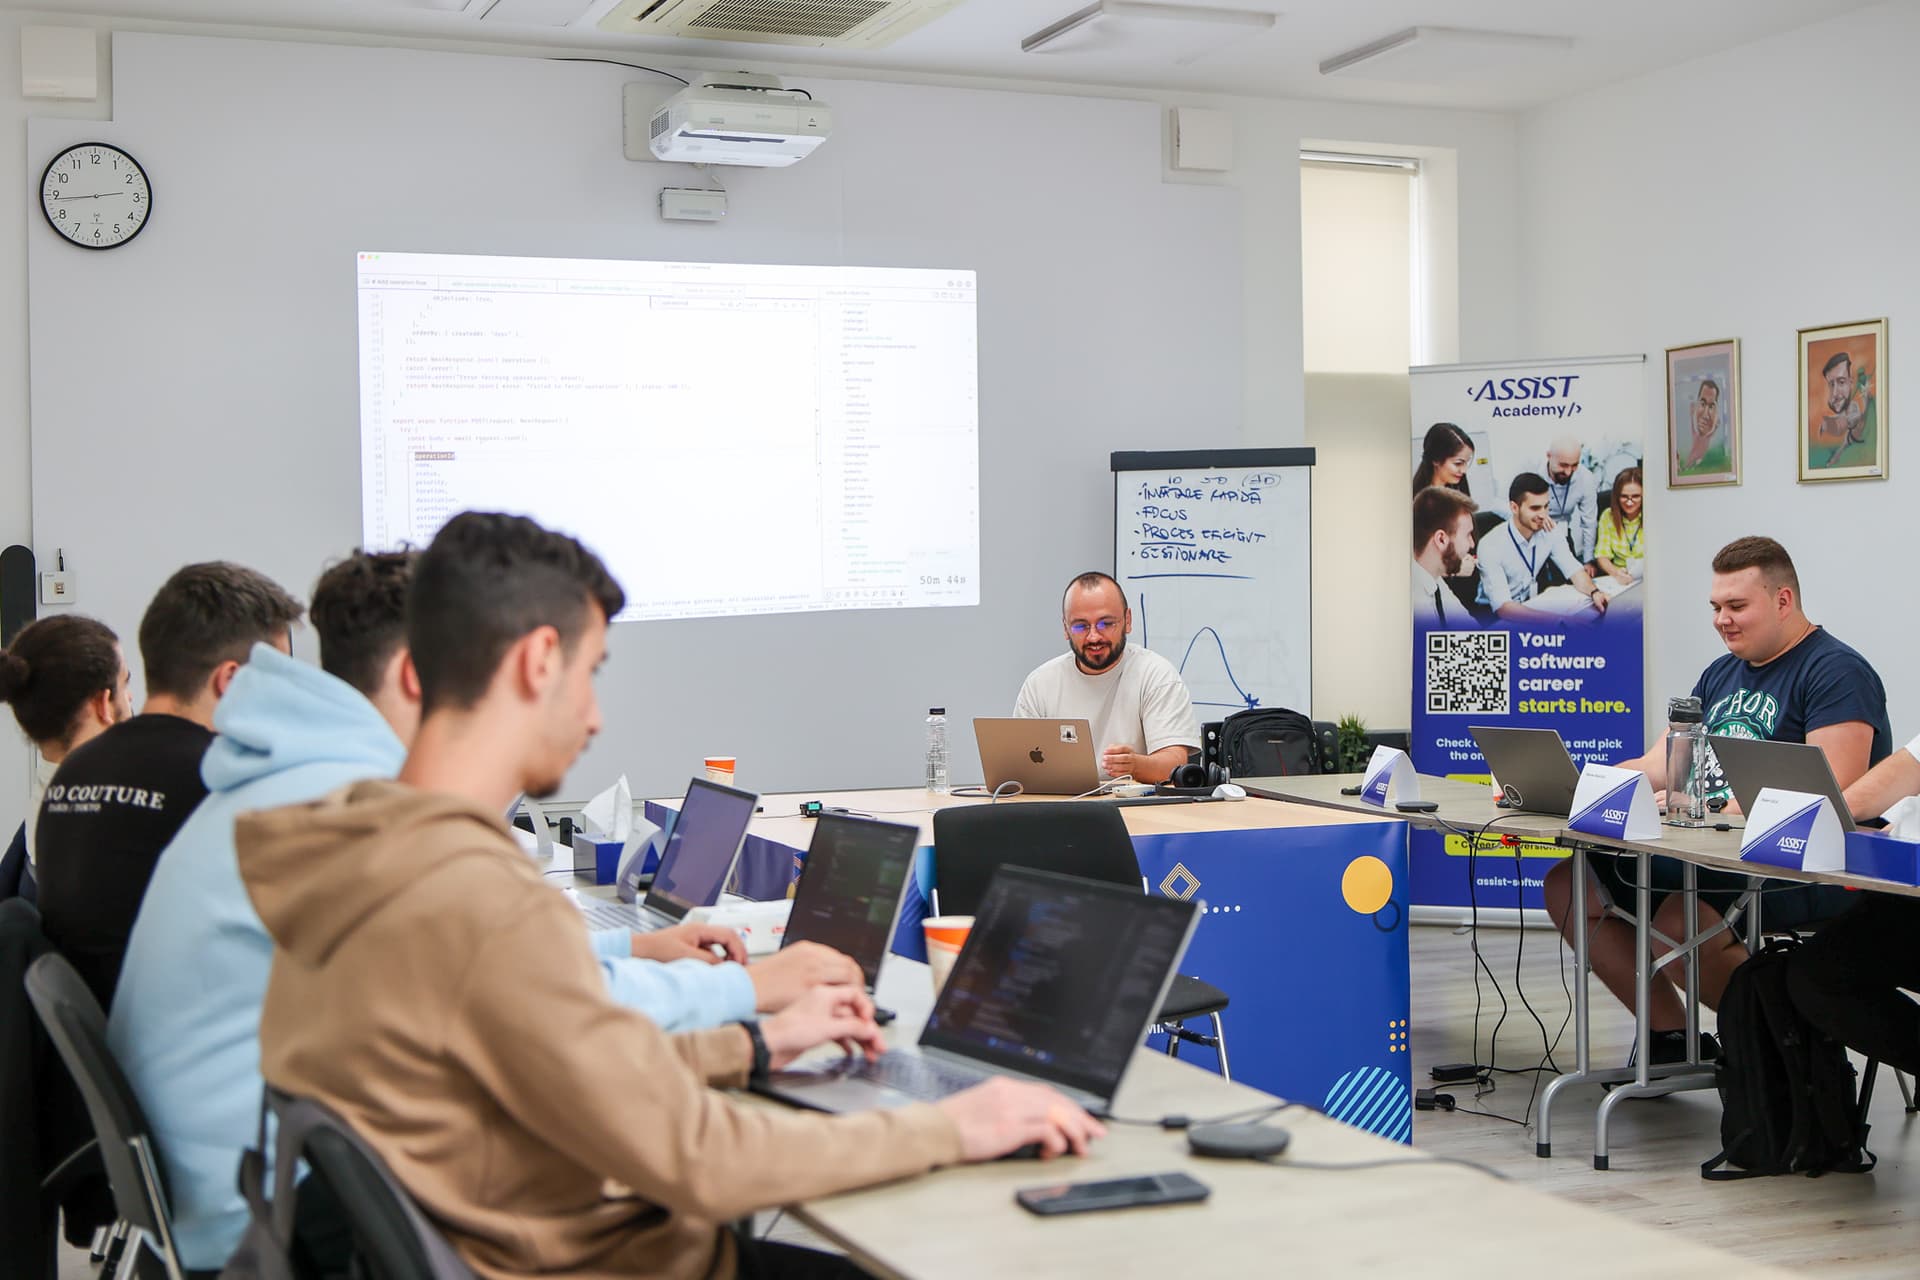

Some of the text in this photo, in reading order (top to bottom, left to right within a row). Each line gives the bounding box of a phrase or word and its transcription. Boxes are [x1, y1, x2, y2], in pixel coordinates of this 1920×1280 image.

[72, 159, 82, 170] 11
[90, 154, 101, 165] 12
[112, 160, 118, 170] 1
[58, 173, 69, 184] 10
[125, 174, 133, 184] 2
[52, 190, 60, 200] 9
[132, 192, 140, 203] 3
[59, 209, 67, 219] 8
[127, 211, 135, 221] 4
[74, 222, 81, 233] 7
[93, 228, 101, 239] 6
[113, 223, 121, 234] 5
[1142, 505, 1188, 521] FOCUS
[1142, 522, 1195, 540] PROCES
[1518, 632, 1566, 648] Your
[1518, 653, 1607, 670] software
[1518, 677, 1584, 692] career
[1518, 697, 1631, 714] starts here.
[1707, 688, 1778, 732] THOR
[1436, 738, 1472, 748] Check
[1573, 738, 1596, 749] and
[1598, 738, 1623, 751] pick
[1450, 751, 1469, 761] the
[1471, 753, 1485, 761] on
[1584, 753, 1609, 764] you:
[67, 784, 166, 811] COUTURE
[1601, 808, 1628, 821] ASSIST
[1776, 837, 1807, 850] ASSIST
